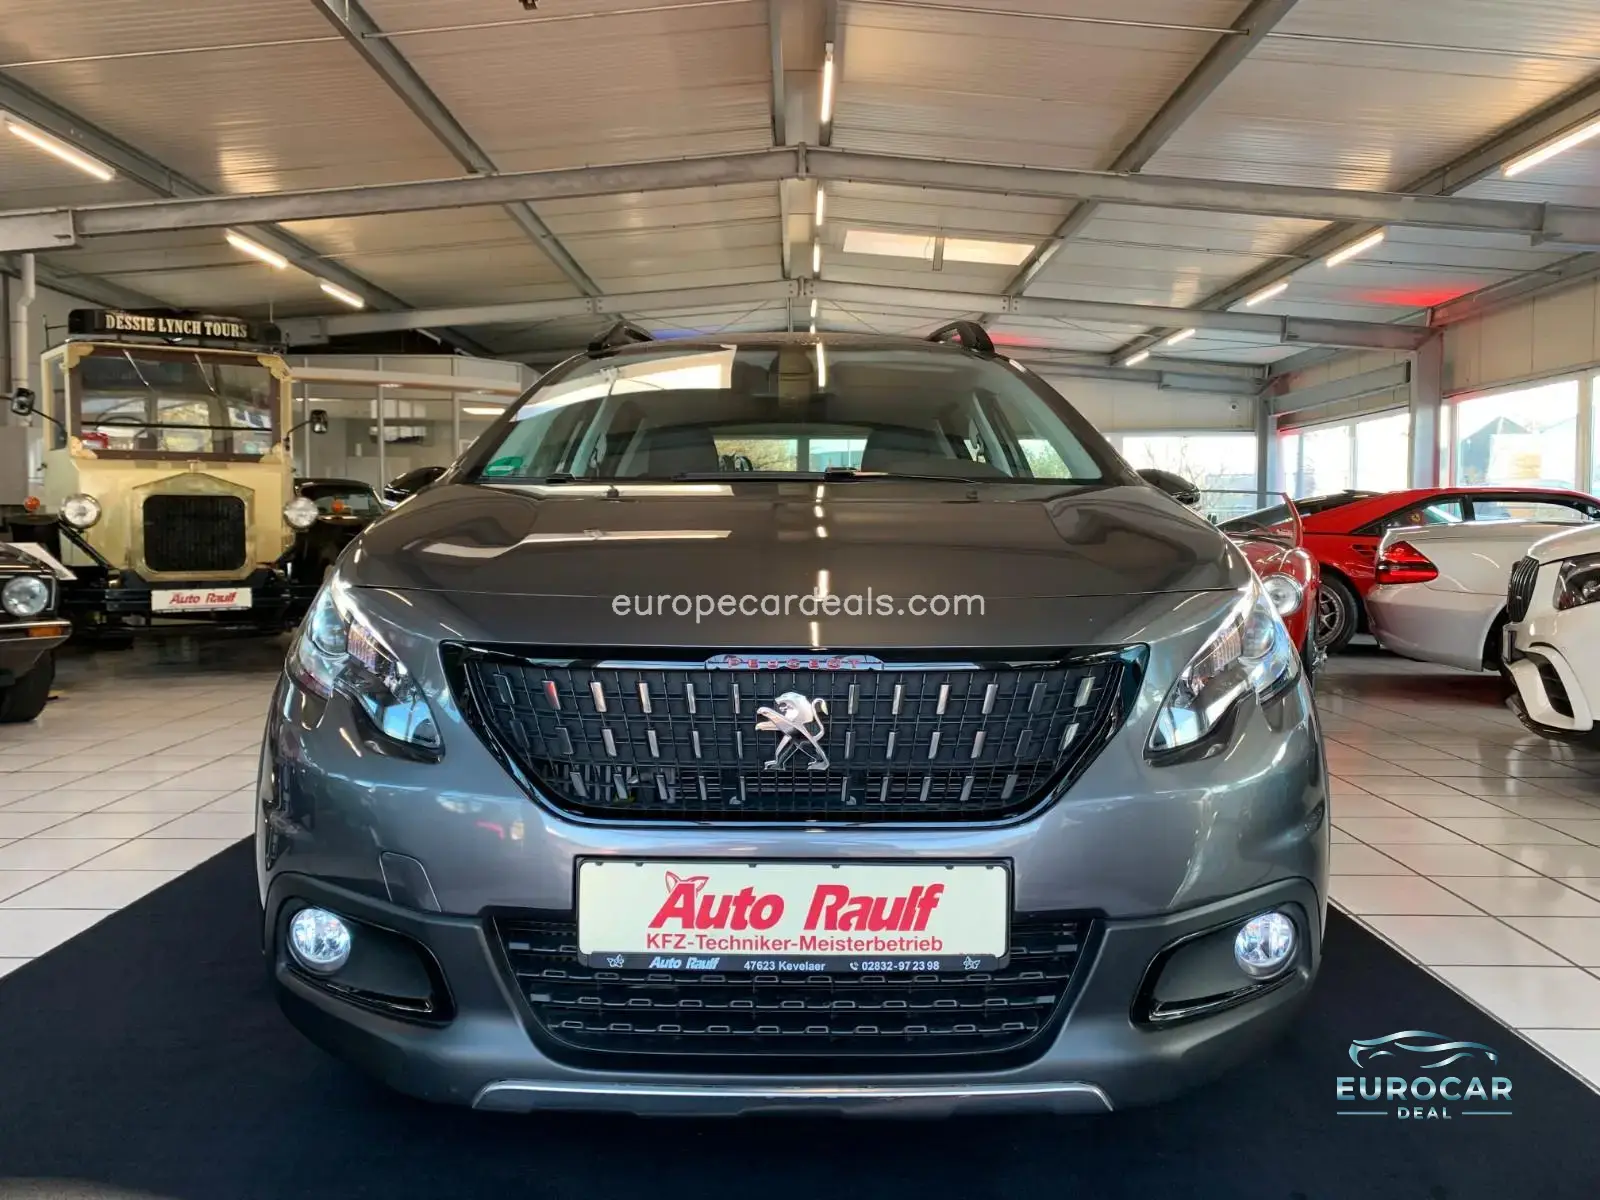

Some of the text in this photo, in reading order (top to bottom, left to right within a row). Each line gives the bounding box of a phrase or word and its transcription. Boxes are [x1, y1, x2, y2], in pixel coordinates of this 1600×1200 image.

[105, 314, 248, 338] DESSIE LYNCH TOURS
[169, 593, 200, 604] Auto
[727, 657, 862, 670] PEUGEOT
[648, 882, 945, 932] Auto Raulf
[646, 934, 943, 952] KFZ-Techniker-Meisterbetrieb
[649, 956, 682, 969] Auto
[744, 961, 775, 971] 47623
[778, 961, 826, 971] Kevelaer
